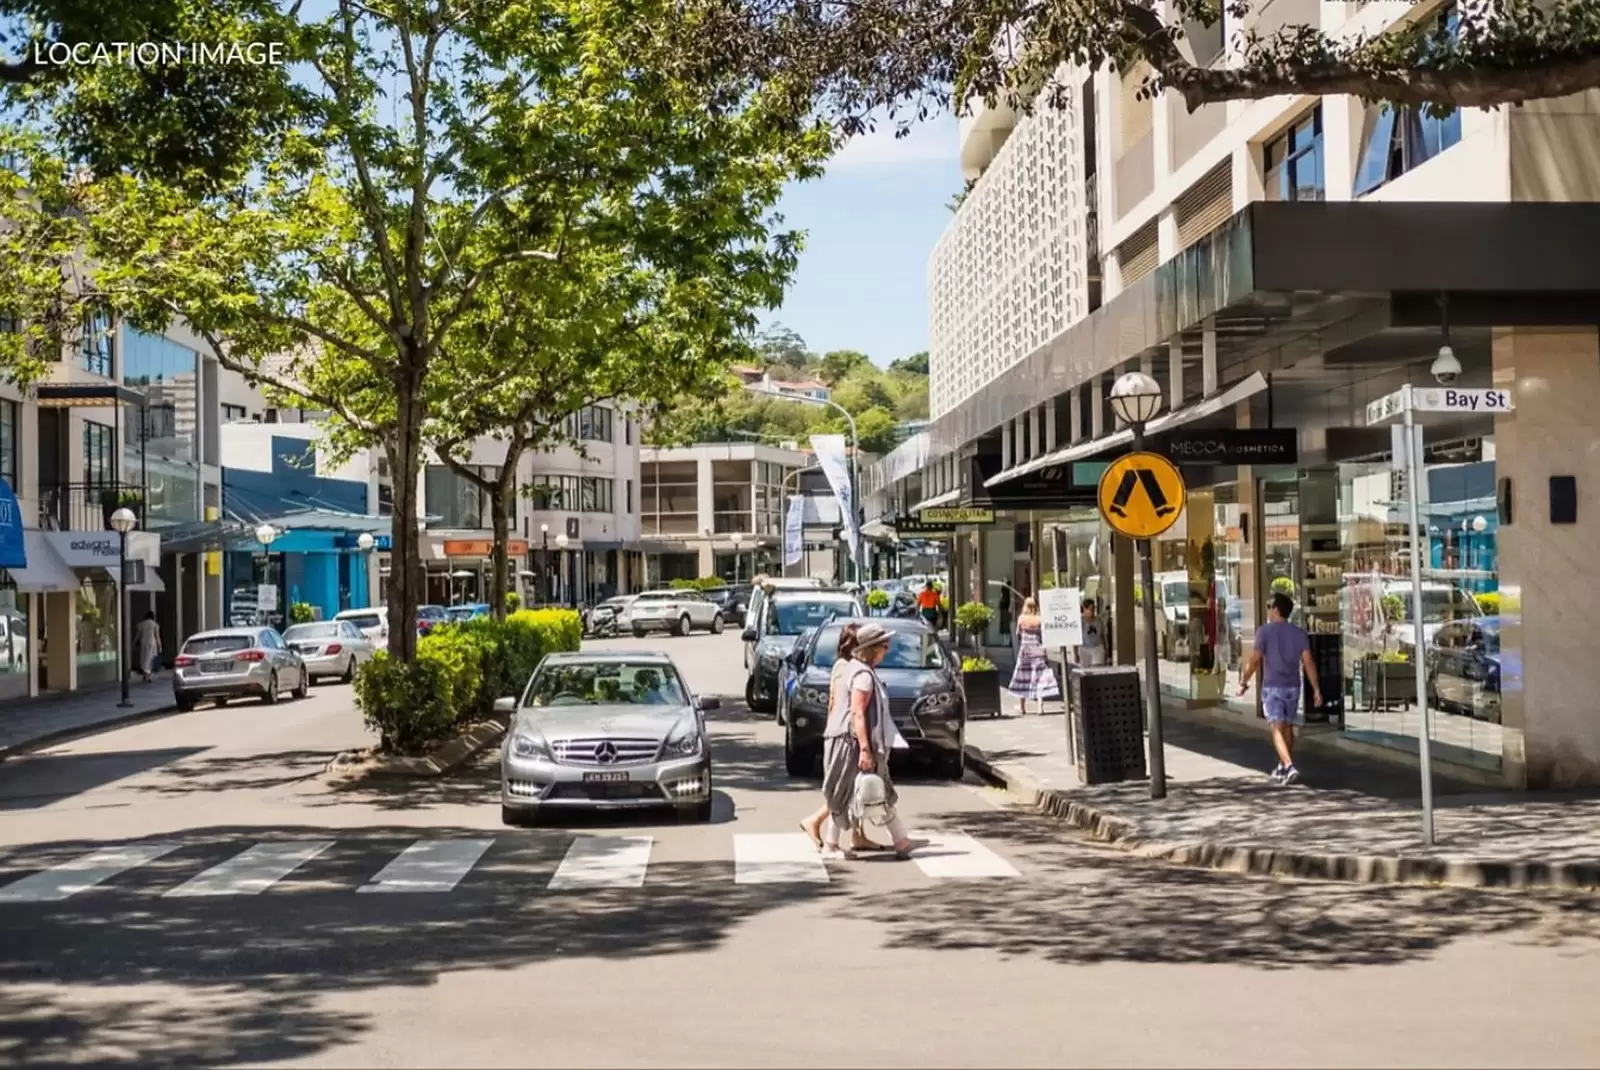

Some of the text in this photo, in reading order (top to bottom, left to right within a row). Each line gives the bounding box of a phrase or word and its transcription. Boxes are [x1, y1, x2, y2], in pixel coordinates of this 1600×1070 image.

[1446, 390, 1506, 410] Bay St
[1170, 440, 1226, 455] MECCA
[1044, 621, 1078, 629] PARKING
